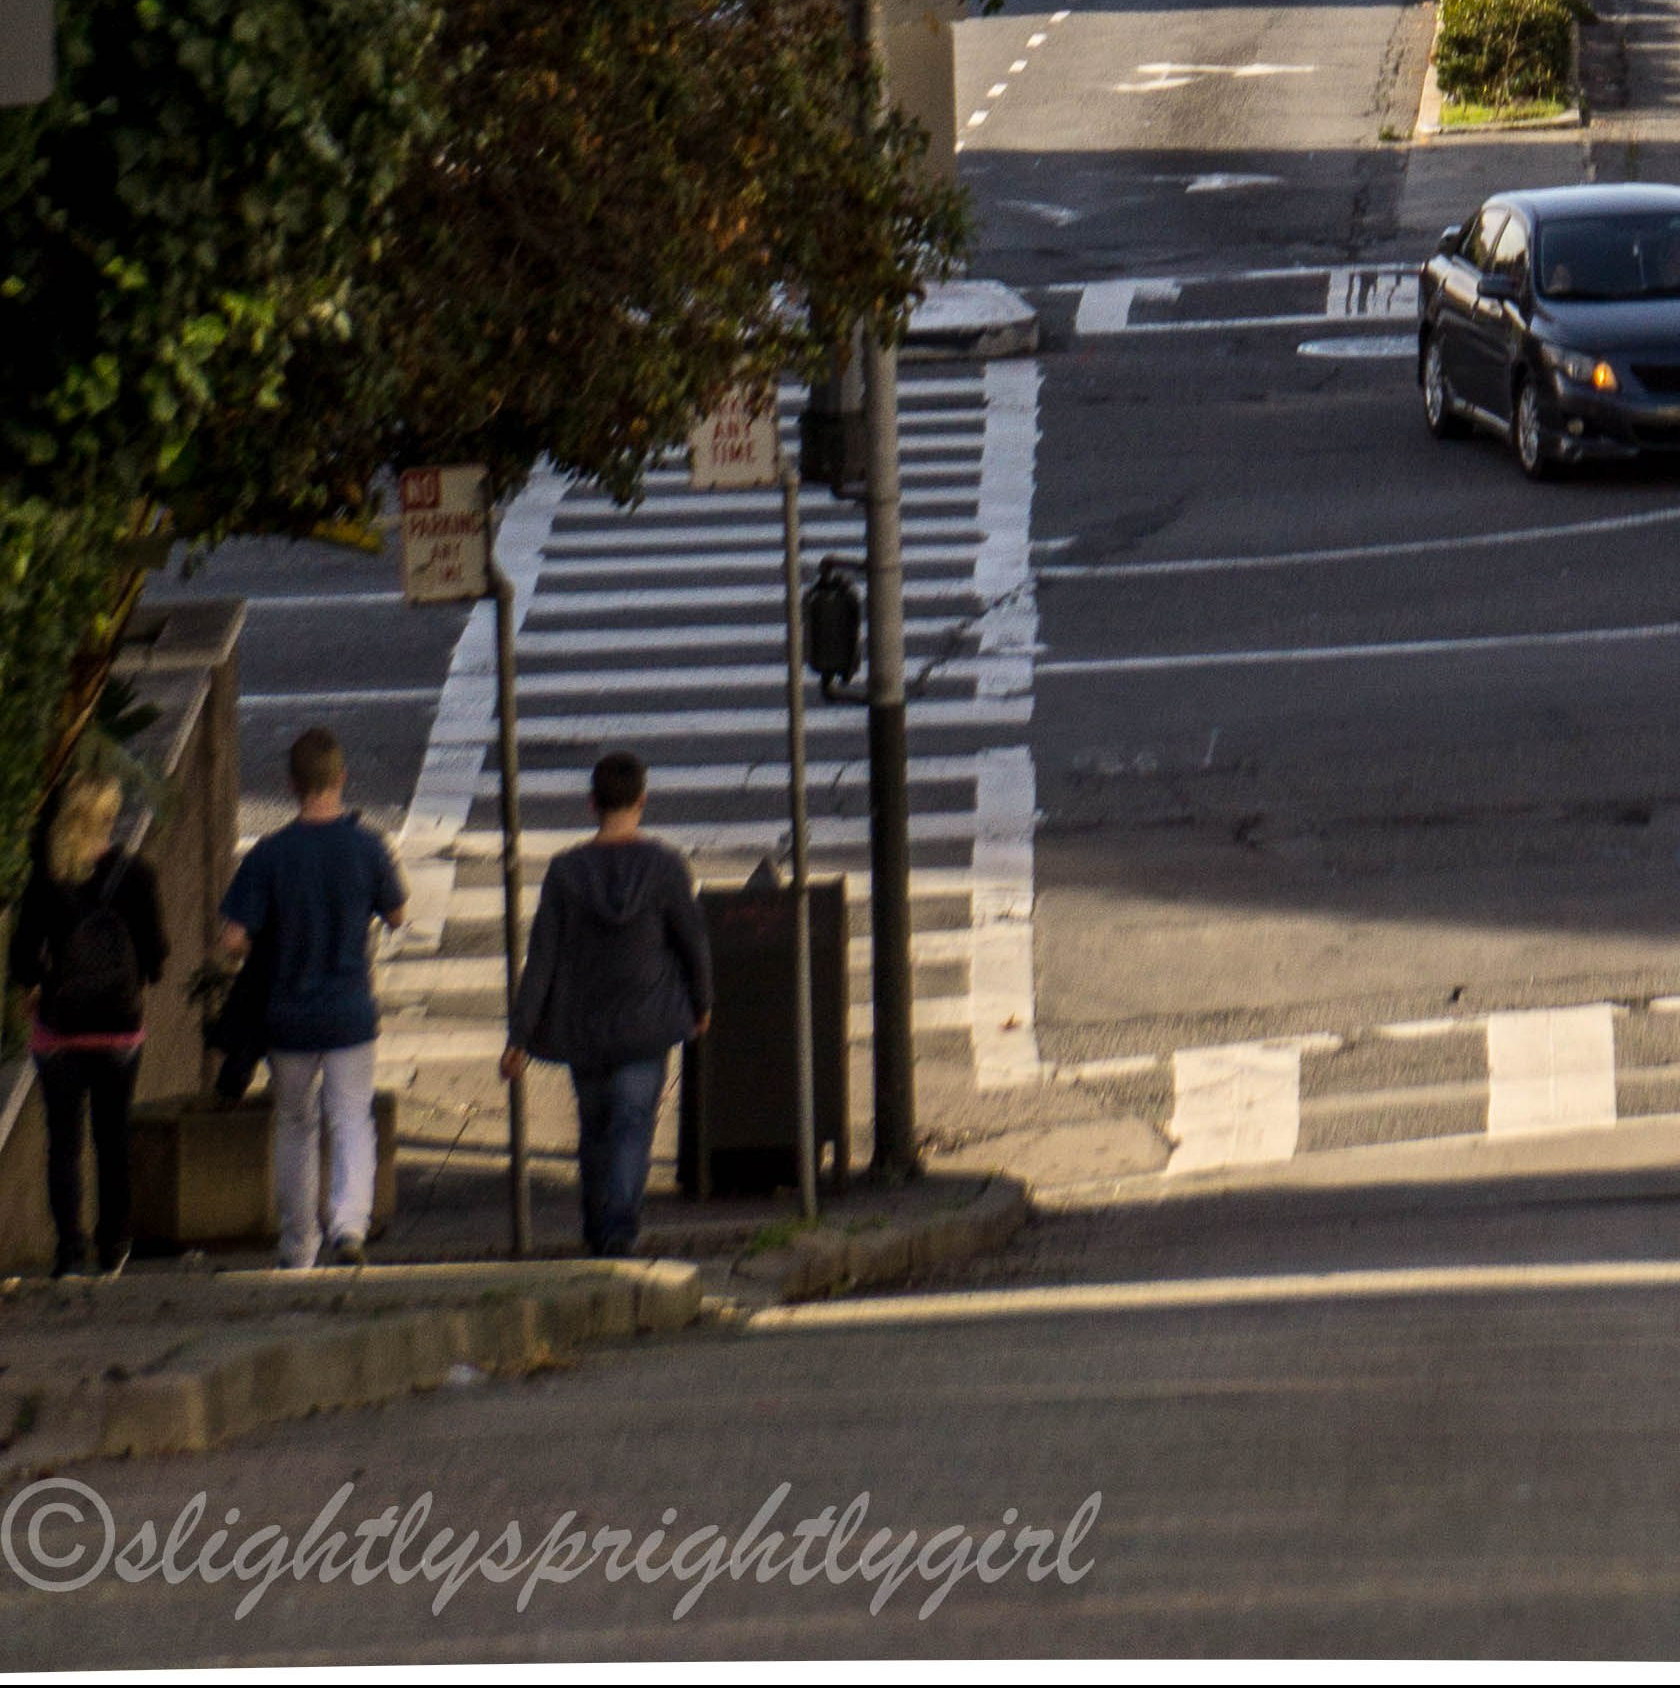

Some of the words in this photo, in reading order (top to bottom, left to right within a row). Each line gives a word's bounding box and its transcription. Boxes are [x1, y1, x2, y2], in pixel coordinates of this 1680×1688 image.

[712, 421, 753, 440] ANY
[711, 441, 756, 466] TIME
[405, 473, 438, 505] NO
[408, 512, 482, 539] PARKING
